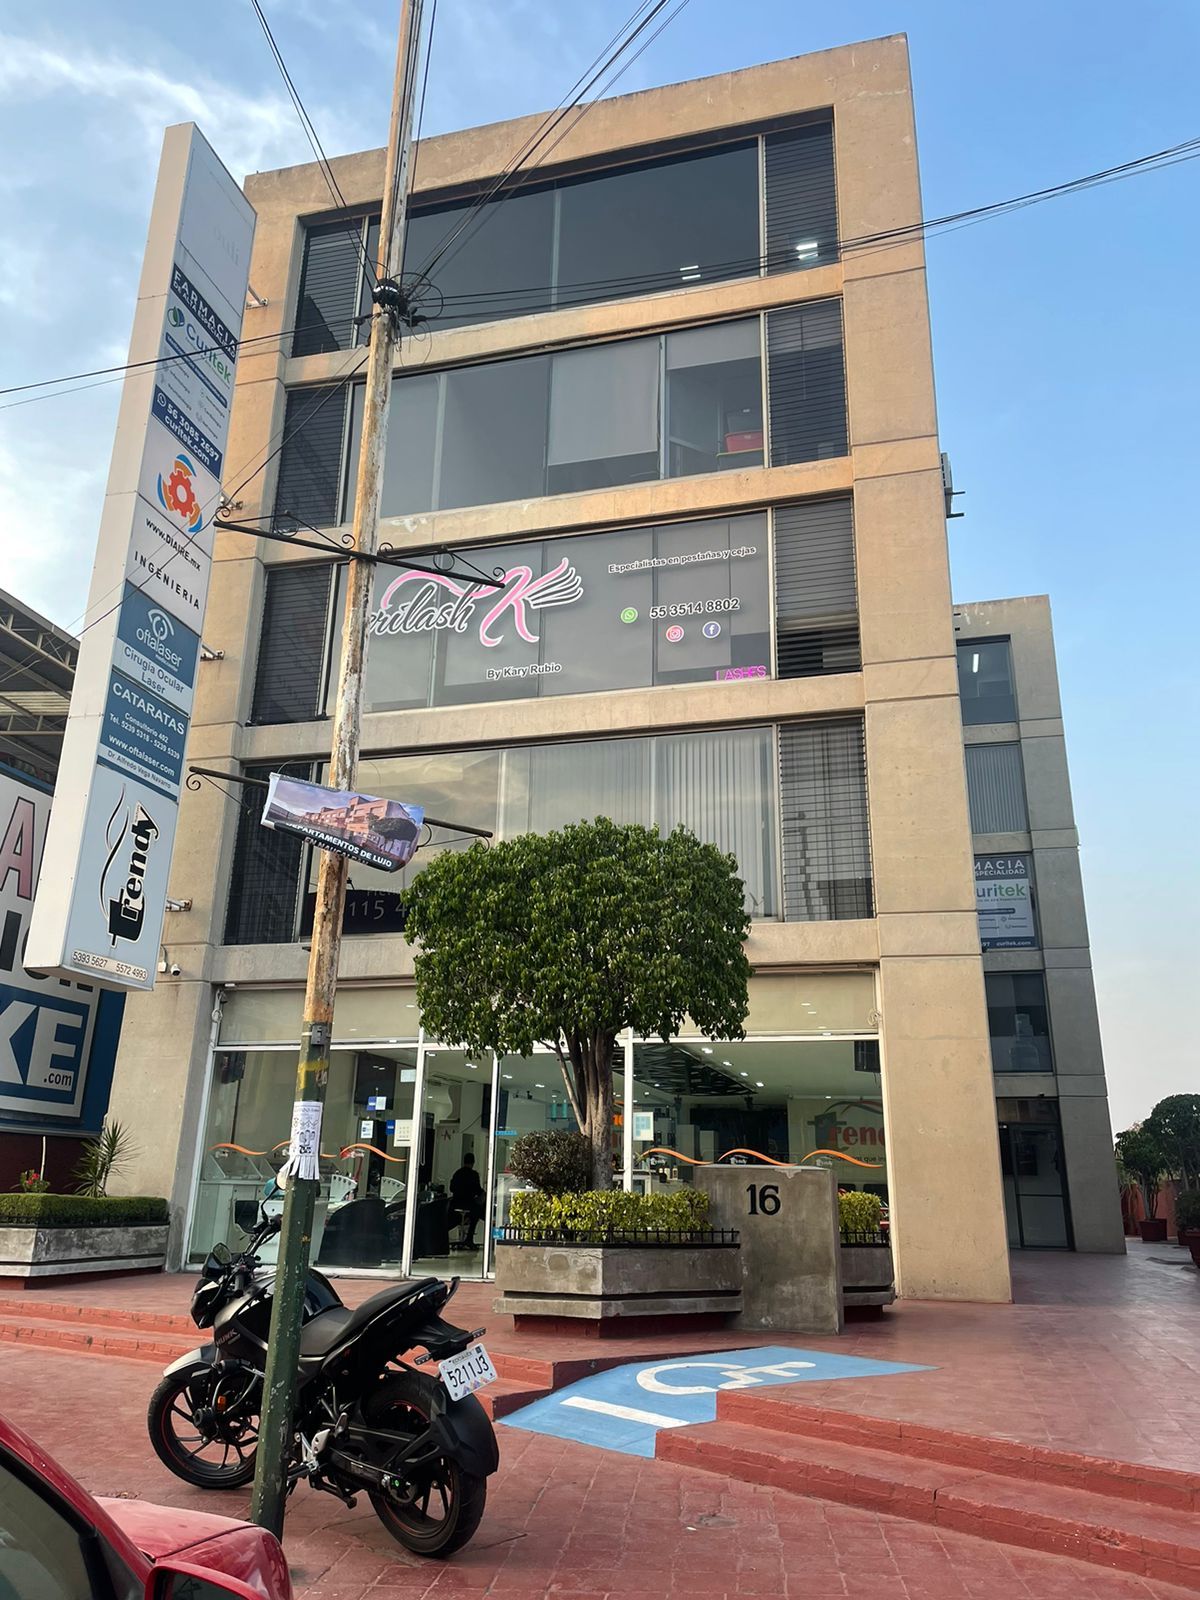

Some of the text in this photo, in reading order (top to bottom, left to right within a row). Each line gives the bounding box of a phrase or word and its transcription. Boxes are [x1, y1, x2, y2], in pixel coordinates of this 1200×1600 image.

[174, 270, 236, 350] FARMACIA
[186, 323, 232, 384] Curitek
[164, 415, 210, 465] curitek.com
[167, 403, 179, 420] 56
[179, 416, 200, 442] 3085
[200, 438, 219, 461] 2697
[145, 517, 201, 571] www.DIAIRE.mx
[608, 546, 756, 573] Especialistas en pestañas y cejas
[134, 550, 200, 610] INGENIERIA
[650, 598, 740, 619] 55 3514 8802
[136, 628, 182, 667] oftalaser
[141, 672, 166, 694] Laser
[157, 669, 184, 693] Ocular
[487, 663, 561, 682] By Kary Rubio
[109, 713, 120, 726] Tel.
[112, 682, 185, 735] CATARATAS
[124, 712, 158, 737] Consultorio
[108, 734, 175, 777] www.oftalaser.com
[360, 849, 372, 860] DE
[372, 854, 392, 867] LUJO
[73, 951, 147, 979] 5393 5627 5572 4993
[44, 1071, 73, 1088] .com
[746, 1184, 782, 1216] 16
[447, 1355, 490, 1388] 5211J3
